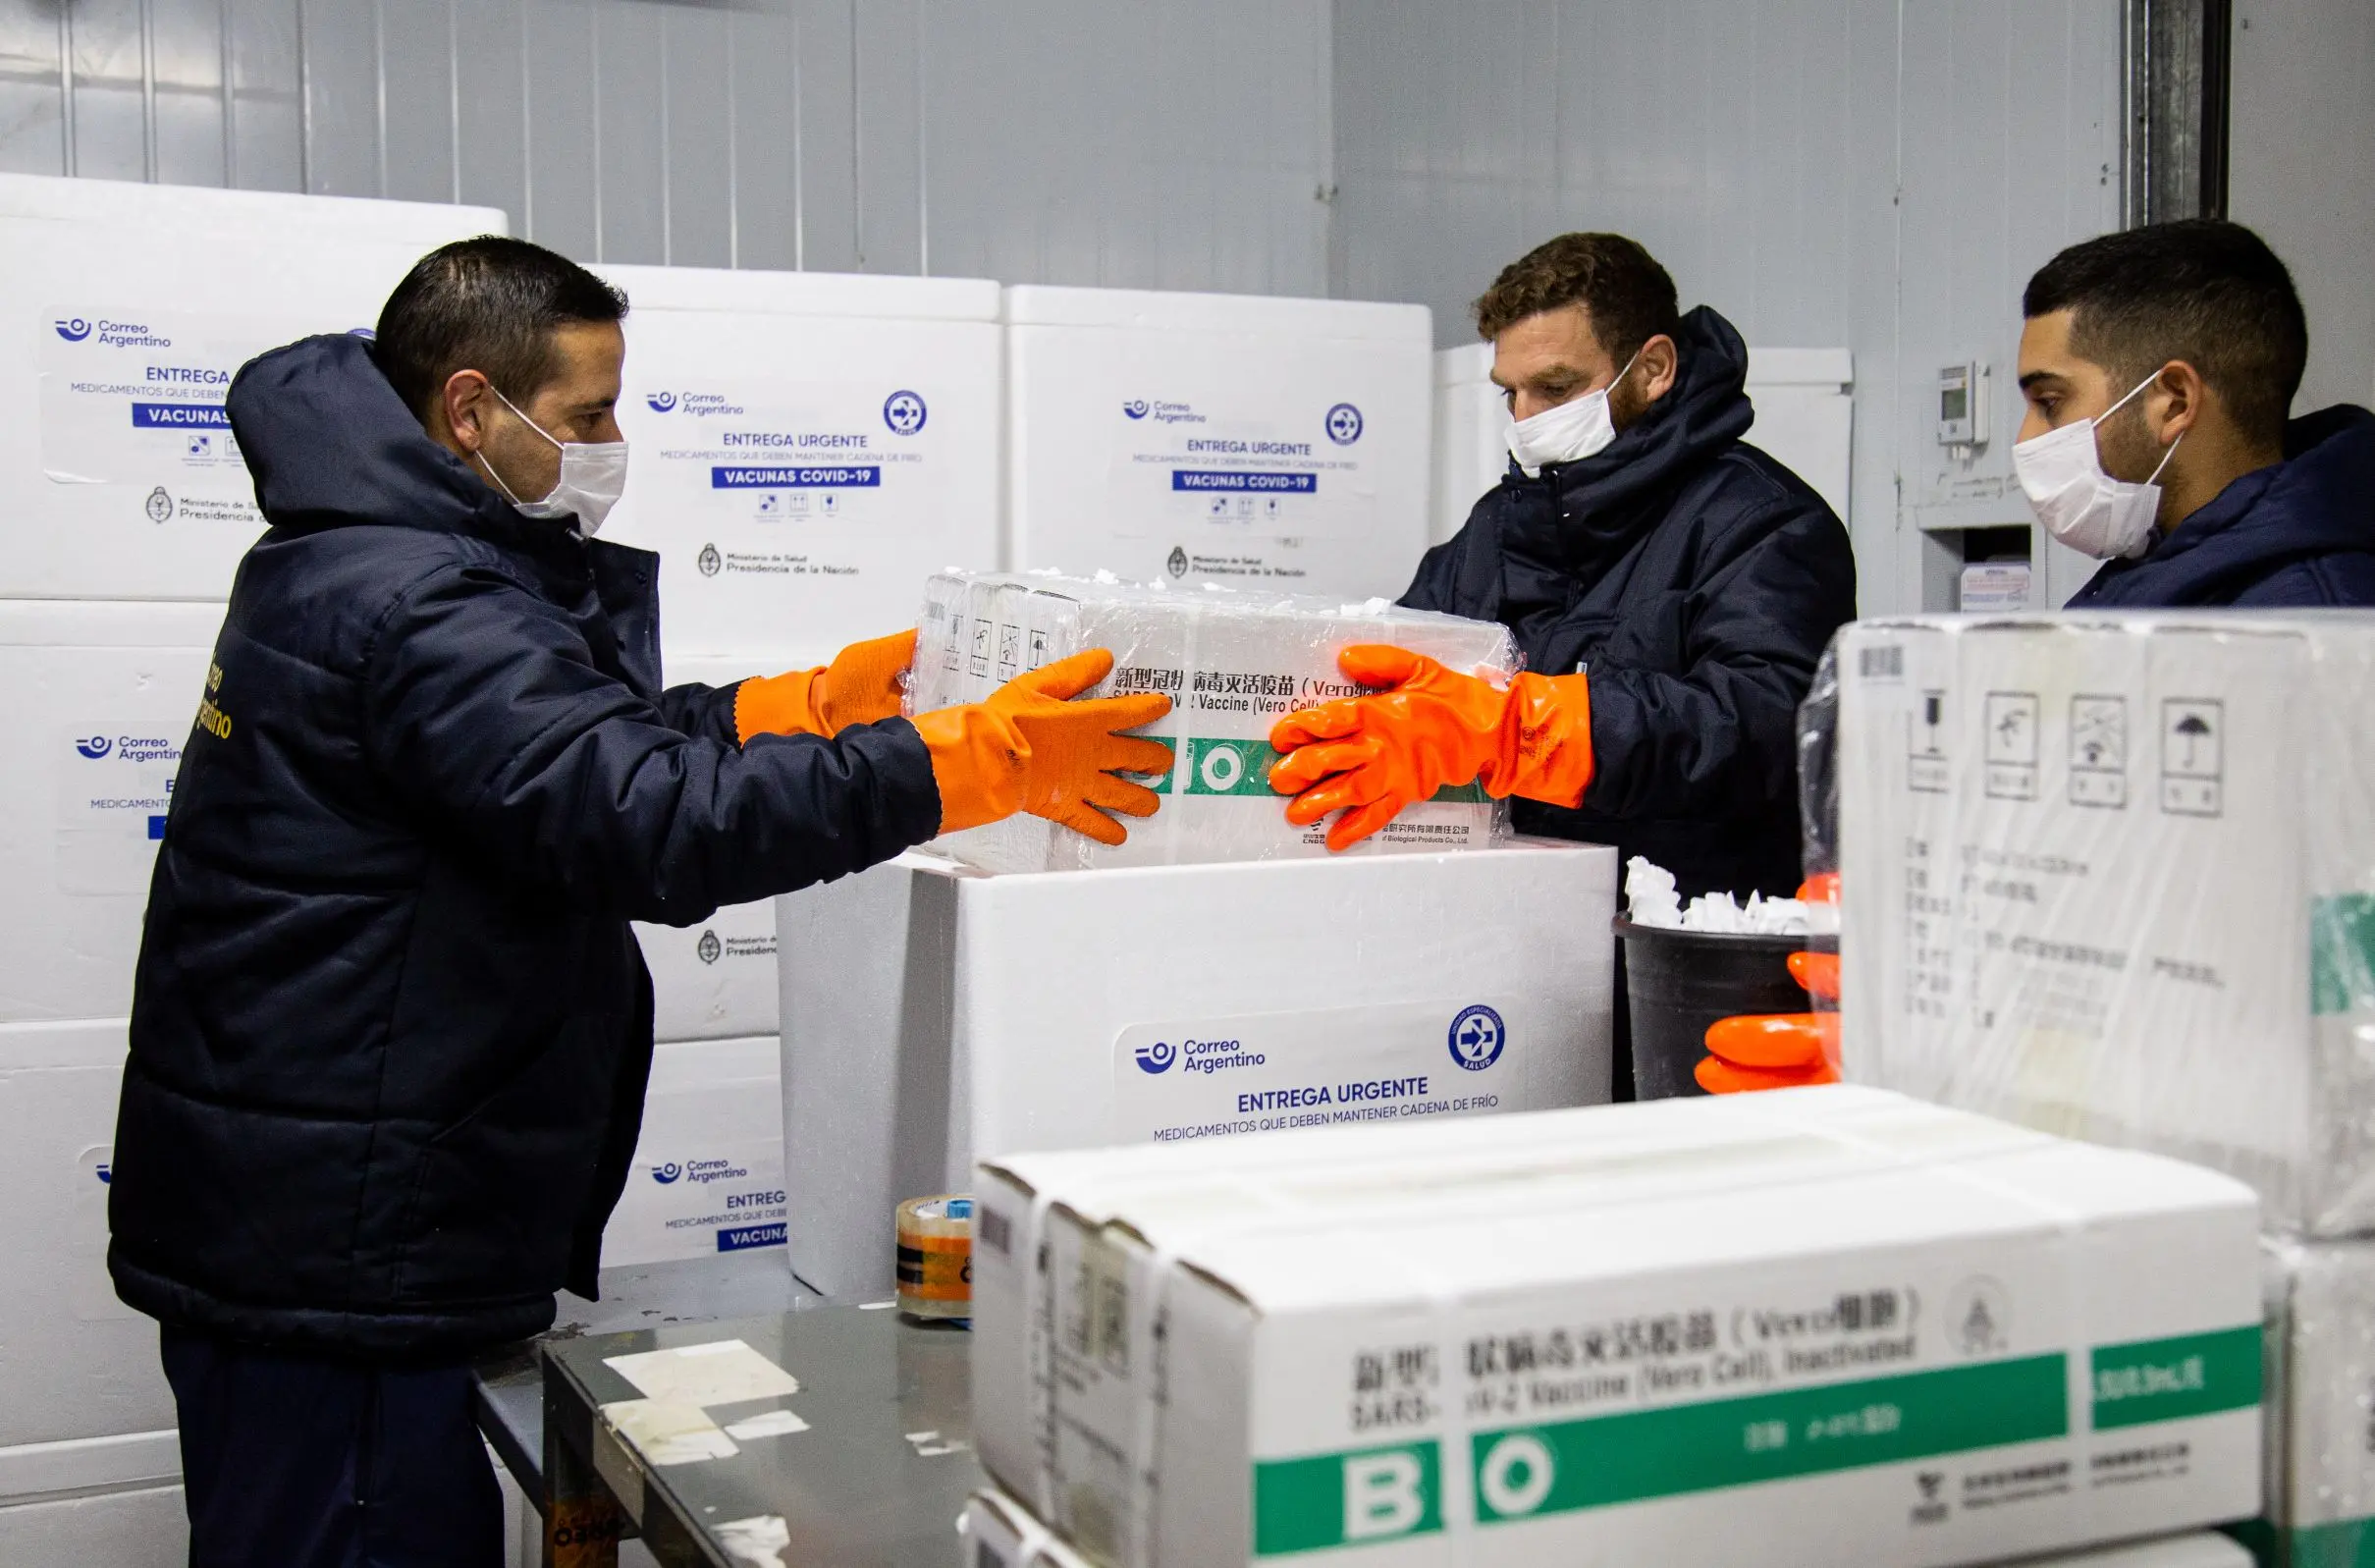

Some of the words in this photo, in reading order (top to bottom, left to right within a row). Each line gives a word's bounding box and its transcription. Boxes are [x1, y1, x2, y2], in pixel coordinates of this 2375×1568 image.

[98, 319, 148, 334] Correo
[98, 332, 172, 348] Argentino
[146, 366, 230, 385] ENTREGA
[71, 382, 163, 397] MEDICAMENTOS
[166, 387, 189, 399] QUE
[682, 392, 725, 404] Correo
[682, 403, 743, 416] Argentino
[1154, 401, 1191, 412] Correo
[1154, 411, 1207, 424] Argentino
[724, 432, 793, 448] ENTREGA
[798, 433, 868, 449] URGENTE
[1187, 439, 1248, 454] ENTREGA
[1252, 442, 1312, 456] URGENTE
[725, 470, 797, 484] VACUNAS
[799, 469, 872, 483] COVID-19
[1183, 474, 1245, 488] VACUNAS
[1248, 475, 1310, 489] COVID-19
[180, 497, 229, 510] Ministerio
[232, 499, 244, 510] de
[180, 508, 254, 523] Presidencia
[727, 553, 769, 563] Ministerio
[772, 554, 783, 563] de
[784, 553, 808, 564] Salud
[727, 563, 790, 574] Presidencia
[793, 564, 807, 574] de
[810, 564, 820, 574] la
[823, 565, 859, 576] Nación
[1192, 565, 1246, 575] Presidencia
[1250, 566, 1261, 576] de
[1199, 693, 1249, 711] Vaccine
[1253, 696, 1286, 715] (Vero
[118, 735, 168, 748] Correo
[1387, 836, 1418, 844] Biological
[1184, 1038, 1240, 1055] Correo
[1184, 1051, 1266, 1074] Argentino
[1464, 1057, 1491, 1070] SALUD
[1238, 1084, 1332, 1113] ENTREGA
[1337, 1076, 1429, 1105] URGENTE
[1154, 1119, 1257, 1142] MEDICAMENTOS
[1260, 1116, 1286, 1131] QUE
[1290, 1112, 1330, 1128] DEBEN
[1332, 1107, 1398, 1124] MANTENER
[1400, 1101, 1450, 1117] CADENA
[1453, 1098, 1470, 1111] DE
[1472, 1092, 1499, 1109] FRÍO
[687, 1159, 729, 1171] Correo
[687, 1167, 747, 1184] Argentino
[665, 1213, 741, 1229] MEDICAMENTOS
[742, 1210, 763, 1221] QUE
[1785, 1336, 1916, 1372] Inactivated
